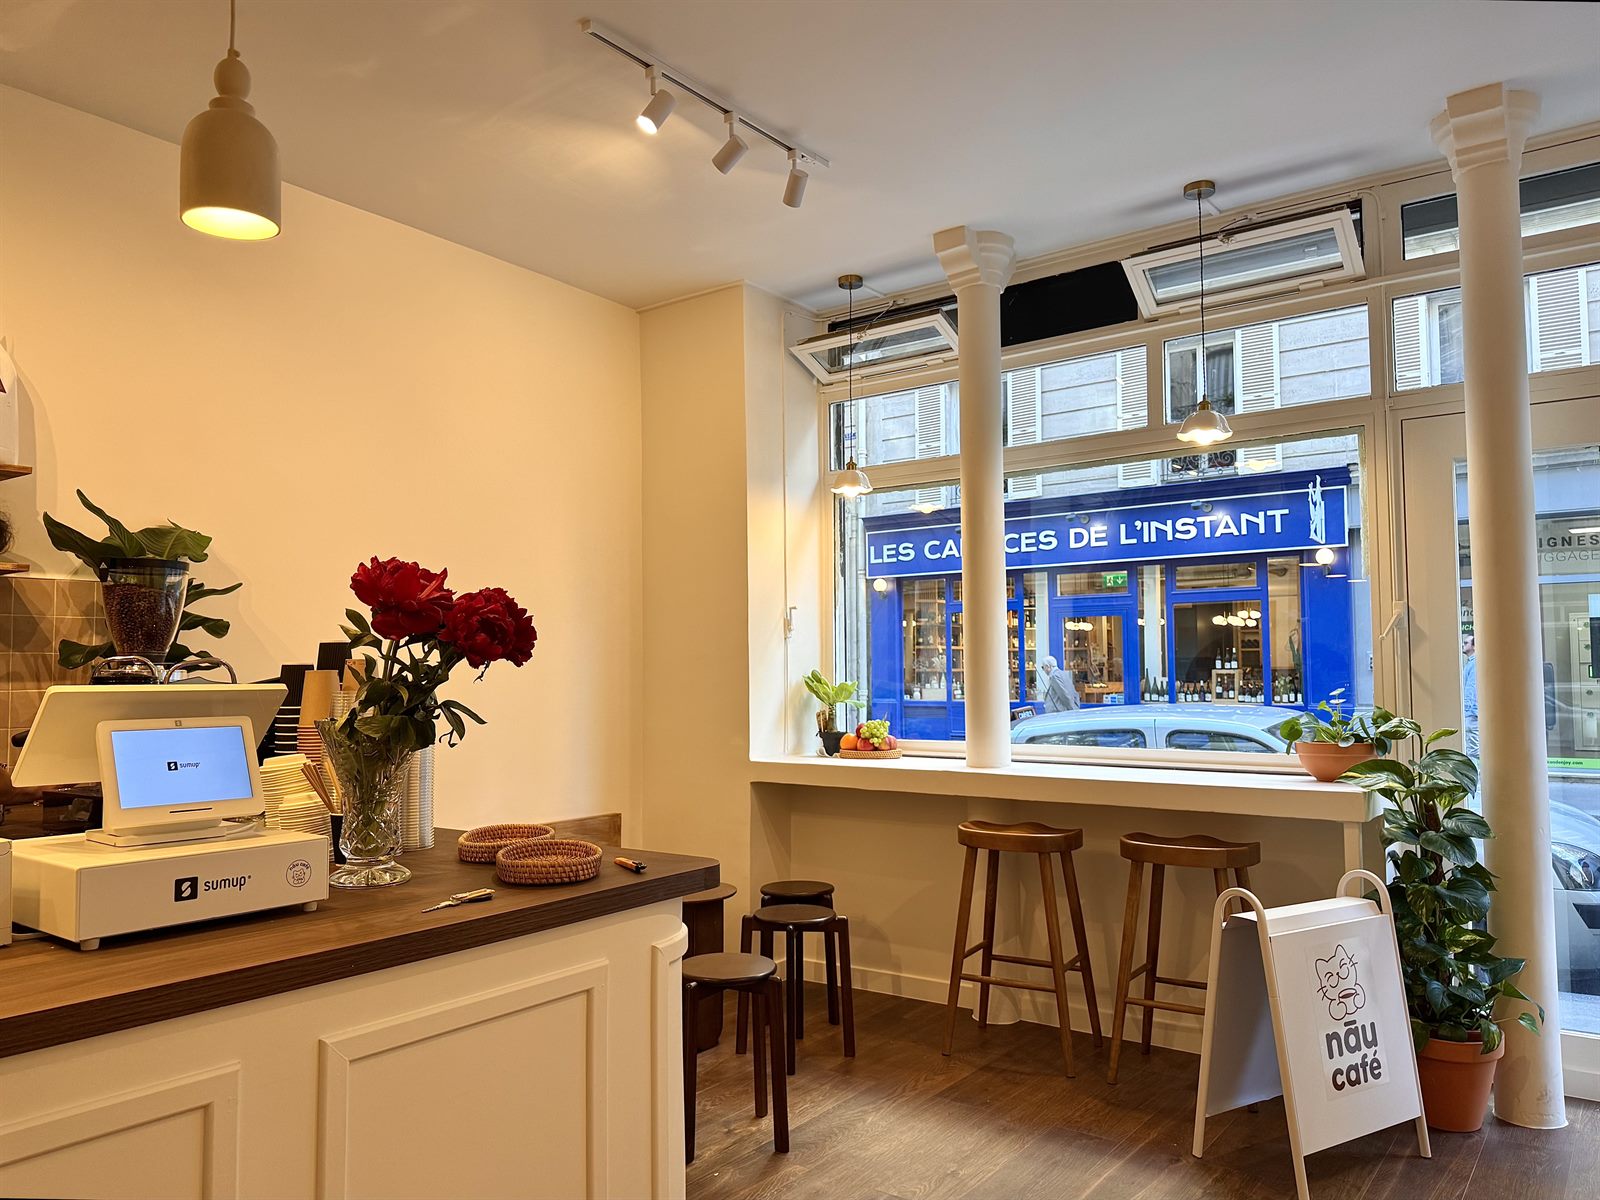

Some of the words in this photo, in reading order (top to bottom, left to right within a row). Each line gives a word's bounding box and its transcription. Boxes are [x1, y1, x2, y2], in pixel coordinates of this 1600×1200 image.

[870, 543, 916, 564] LES
[924, 530, 1058, 560] CACES
[1069, 525, 1108, 549] DE
[1120, 508, 1290, 545] L'INSTANT
[1538, 534, 1600, 549] IGNES
[1543, 549, 1600, 562] GGAGE
[203, 875, 247, 892] sumup
[1325, 1019, 1379, 1060] nāu
[1331, 1049, 1382, 1092] café
